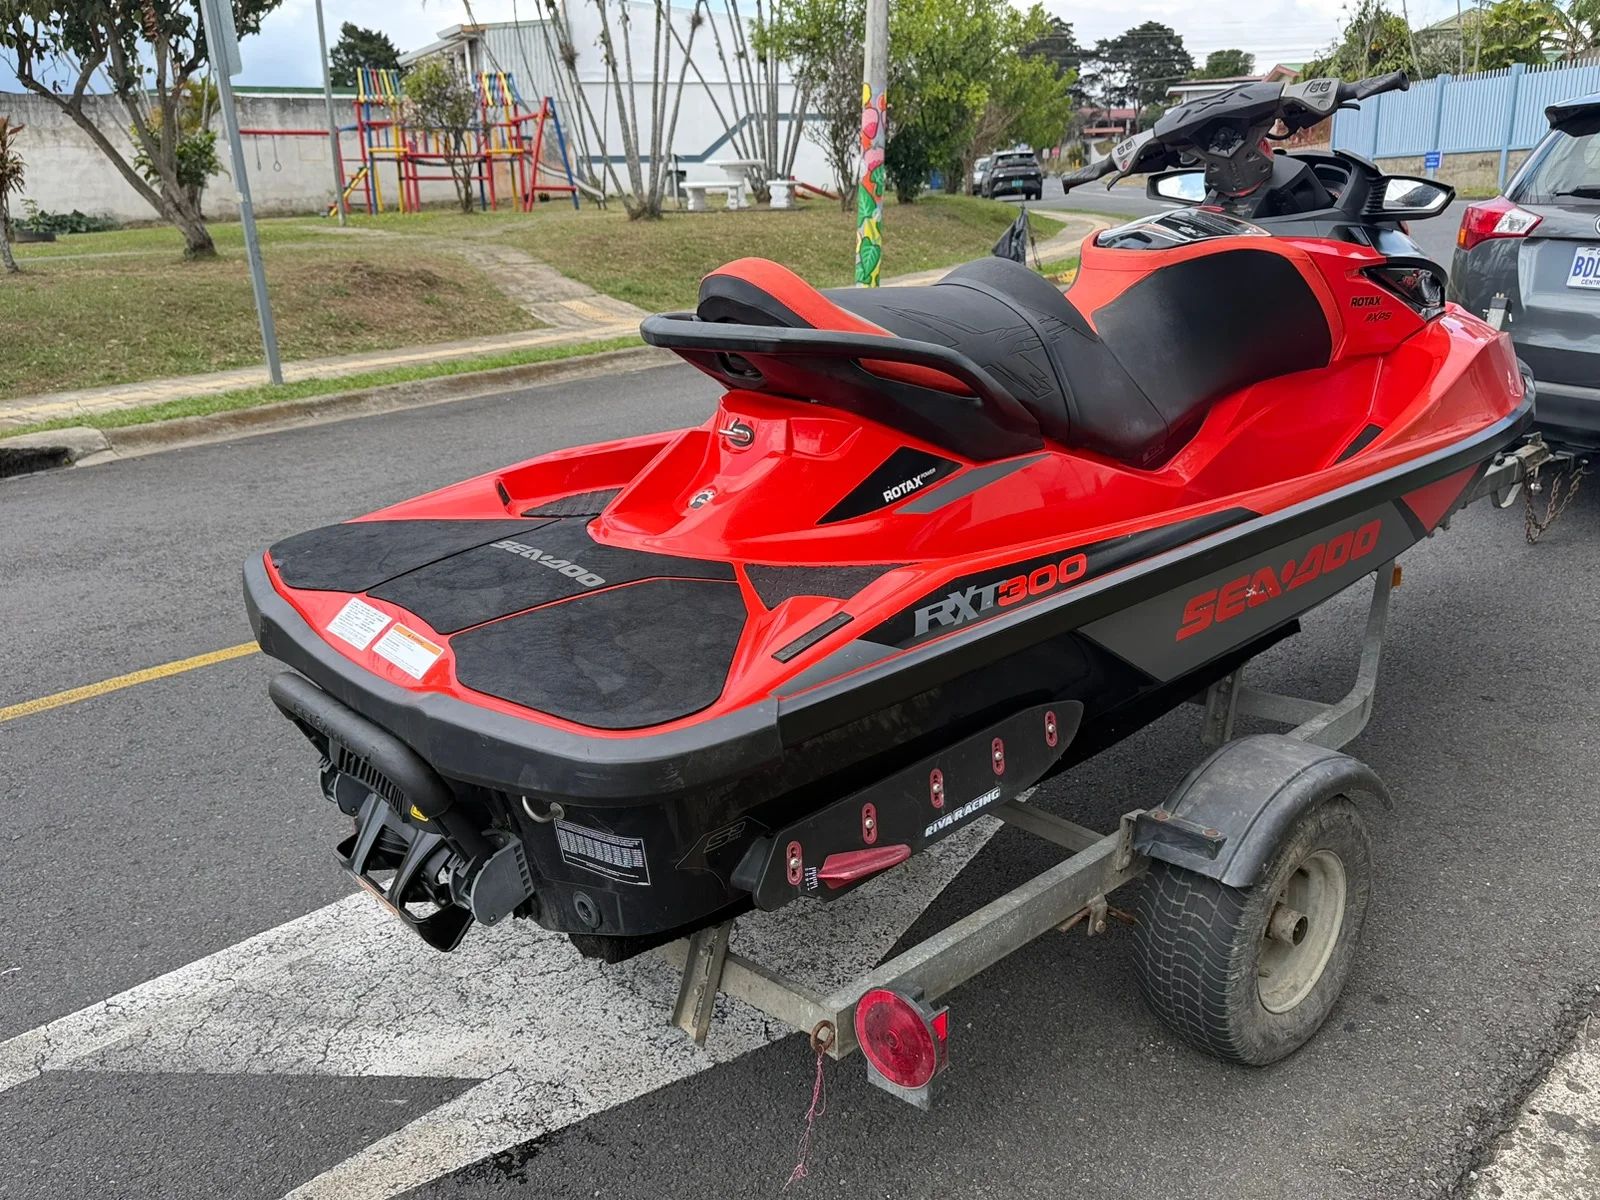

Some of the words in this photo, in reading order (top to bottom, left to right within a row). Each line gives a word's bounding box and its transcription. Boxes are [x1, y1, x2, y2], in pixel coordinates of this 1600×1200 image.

[1351, 296, 1382, 307] ROTAX
[883, 475, 923, 503] ROTAX
[925, 813, 953, 838] RIVA
[953, 788, 1001, 821] RACING
